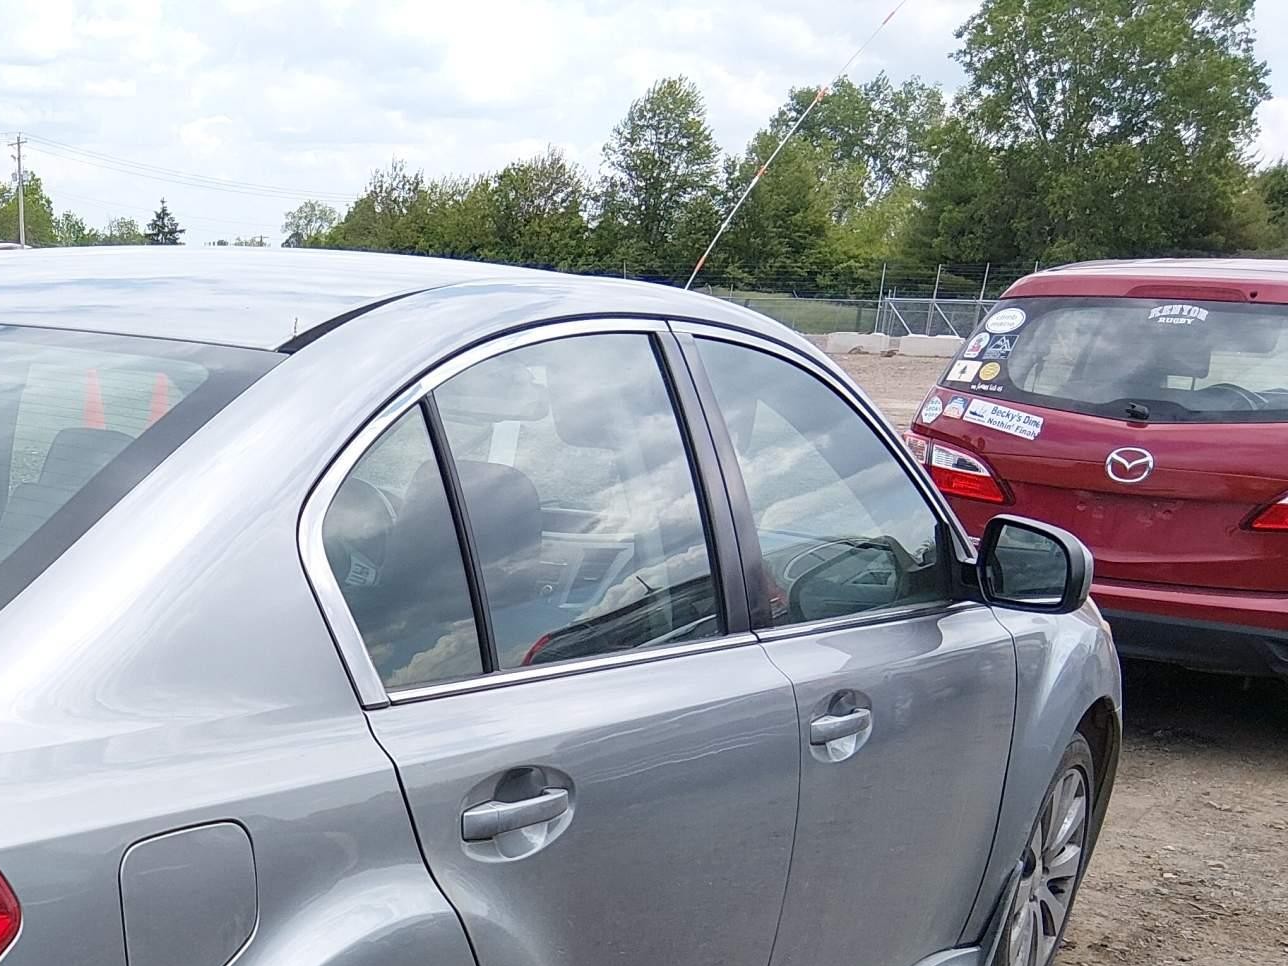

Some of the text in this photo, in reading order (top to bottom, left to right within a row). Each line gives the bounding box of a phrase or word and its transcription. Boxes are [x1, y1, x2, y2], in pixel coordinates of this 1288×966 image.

[1148, 304, 1209, 321] KENYON
[1157, 317, 1194, 325] RUGBY
[991, 406, 1022, 422] Becky's
